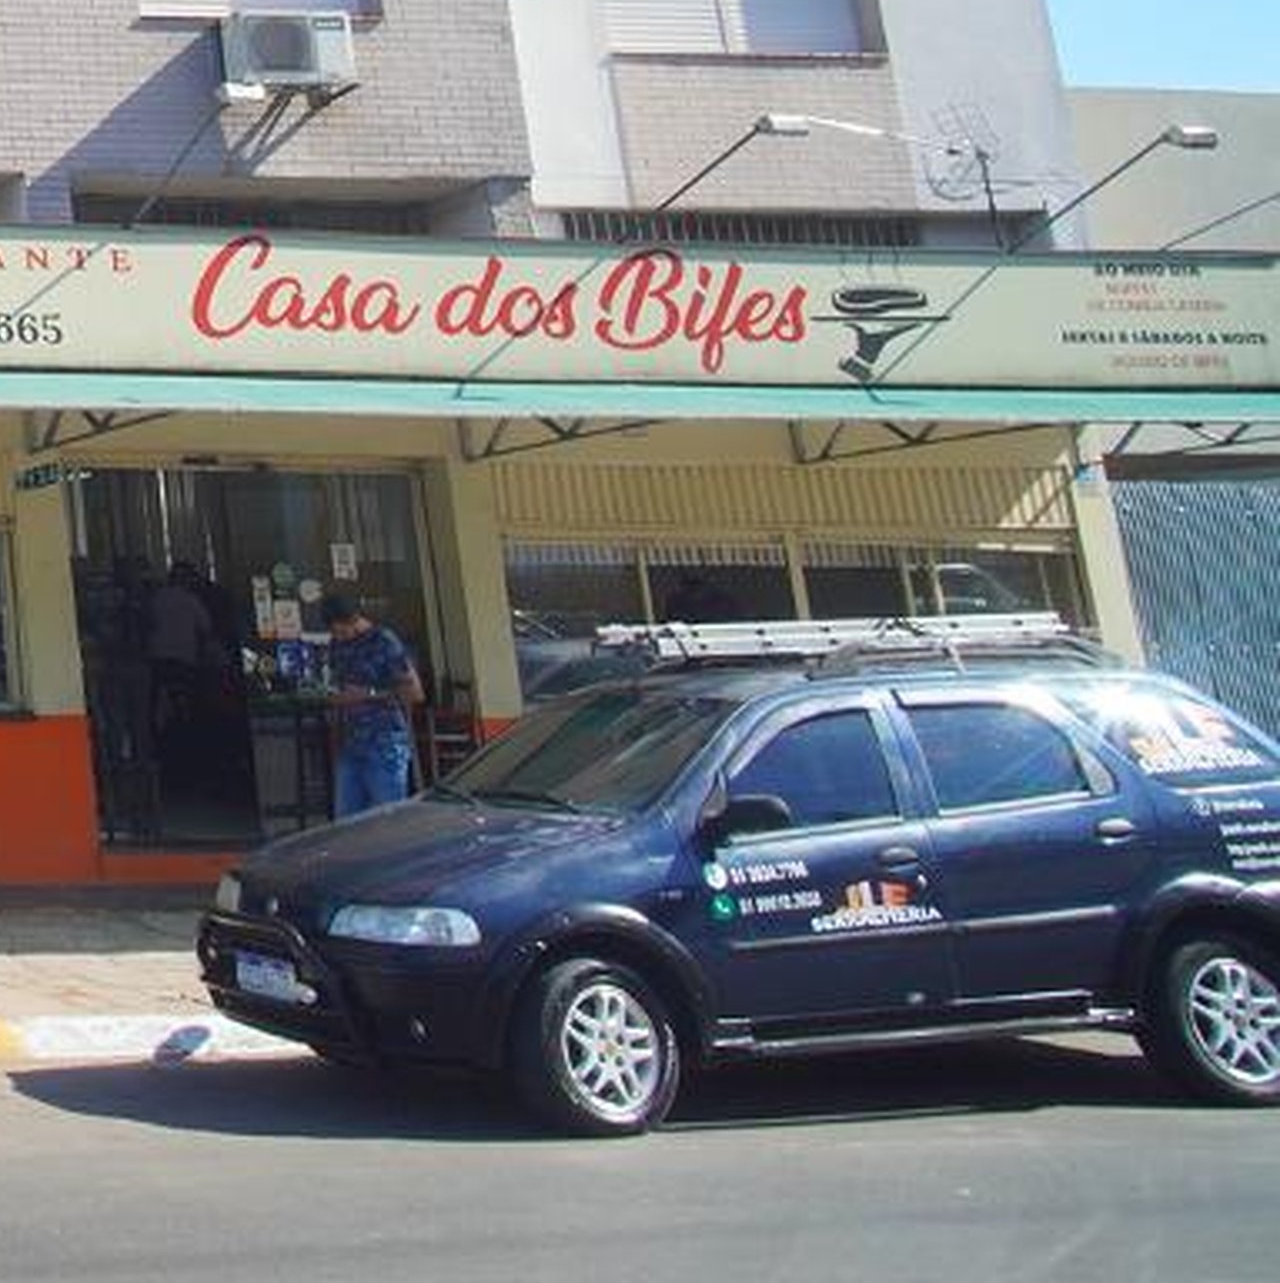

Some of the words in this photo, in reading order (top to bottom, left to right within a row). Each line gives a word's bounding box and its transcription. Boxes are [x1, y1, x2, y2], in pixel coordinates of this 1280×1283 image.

[191, 234, 420, 339] Casa
[435, 255, 579, 339] dos
[594, 248, 808, 374] Bifes
